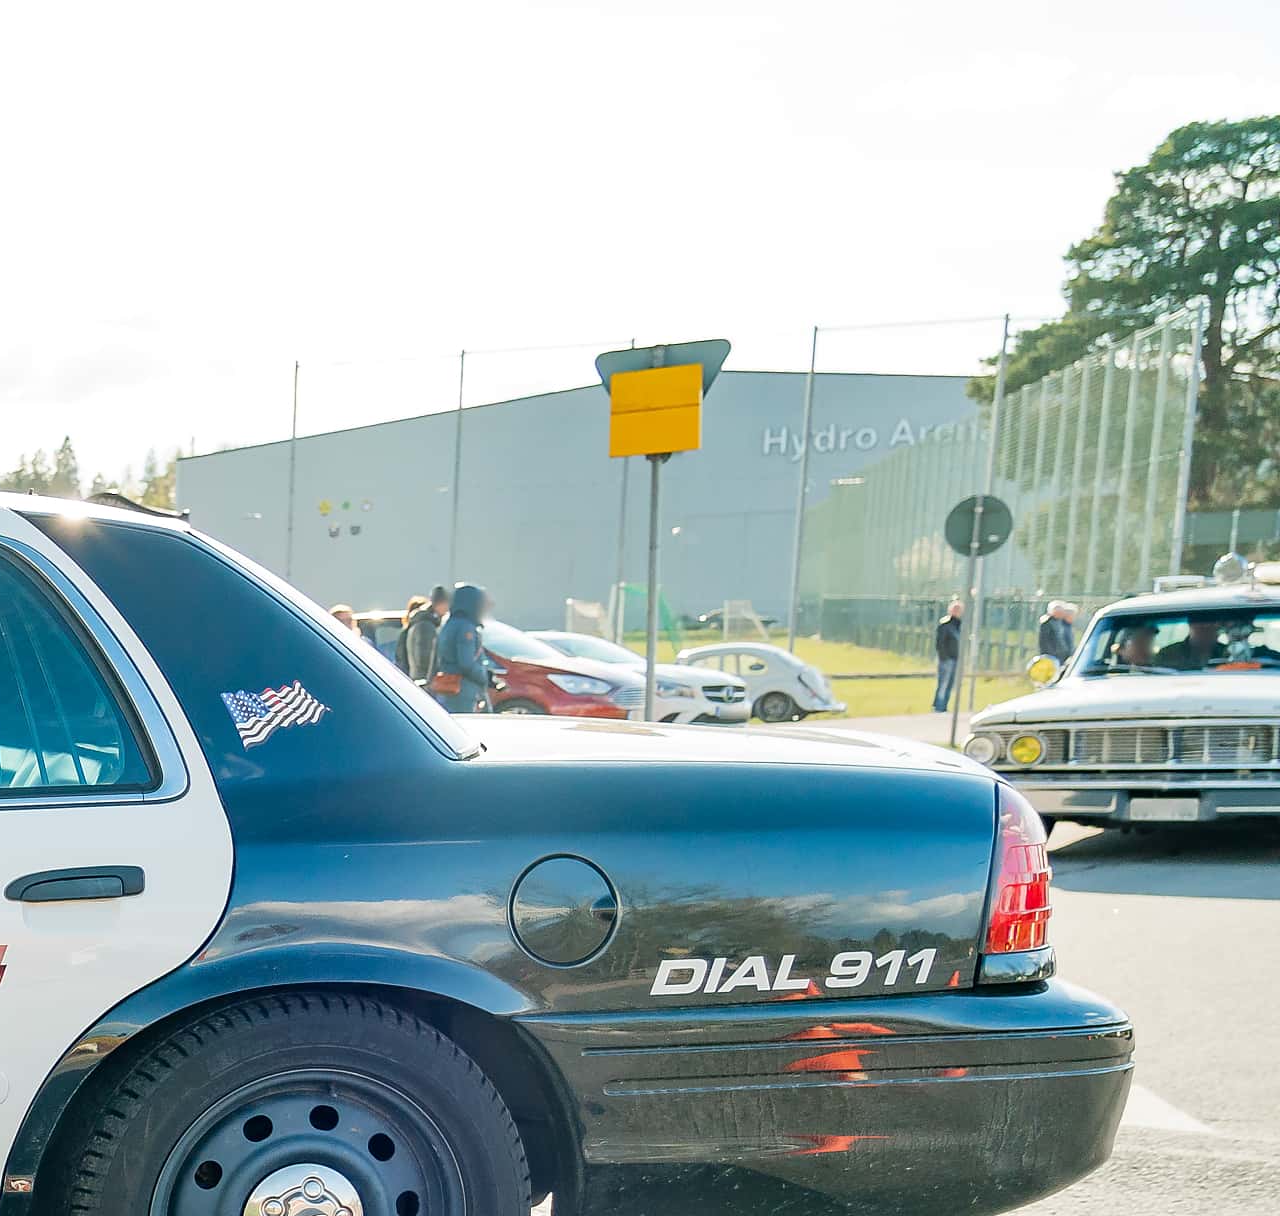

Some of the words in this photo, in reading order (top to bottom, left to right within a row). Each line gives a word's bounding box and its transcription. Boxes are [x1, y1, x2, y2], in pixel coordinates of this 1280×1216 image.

[762, 423, 878, 461] Hydro
[649, 954, 811, 995] DIAL
[825, 948, 937, 988] 911
